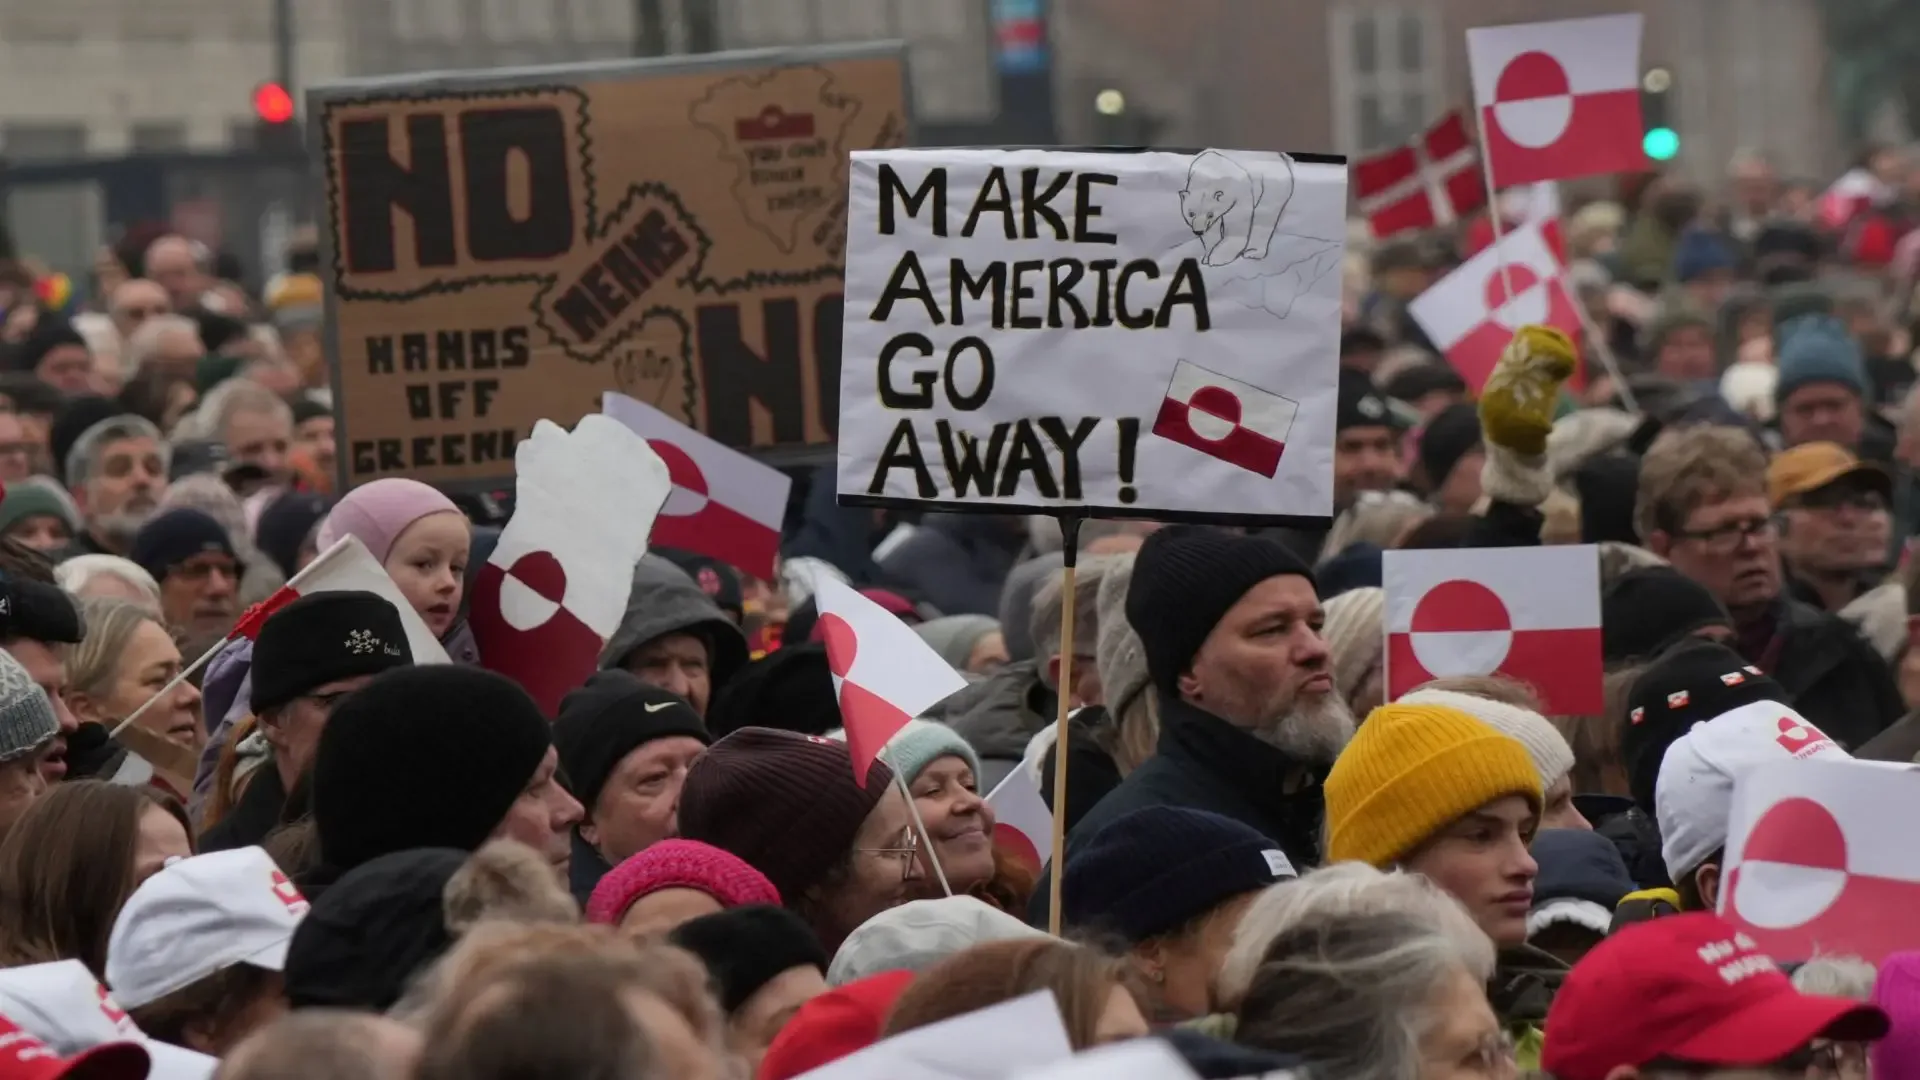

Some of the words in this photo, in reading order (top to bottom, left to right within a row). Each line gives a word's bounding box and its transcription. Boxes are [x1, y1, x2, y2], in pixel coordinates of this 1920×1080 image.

[339, 105, 575, 273] NO
[878, 164, 1118, 245] MAKE
[552, 208, 690, 344] MEANS
[869, 250, 1211, 332] AMERICA
[366, 327, 529, 375] HANDS
[695, 293, 846, 446] N
[878, 332, 995, 411] GO
[405, 379, 498, 420] OFF
[352, 429, 516, 474] GREENL
[867, 416, 1141, 504] AWAY!
